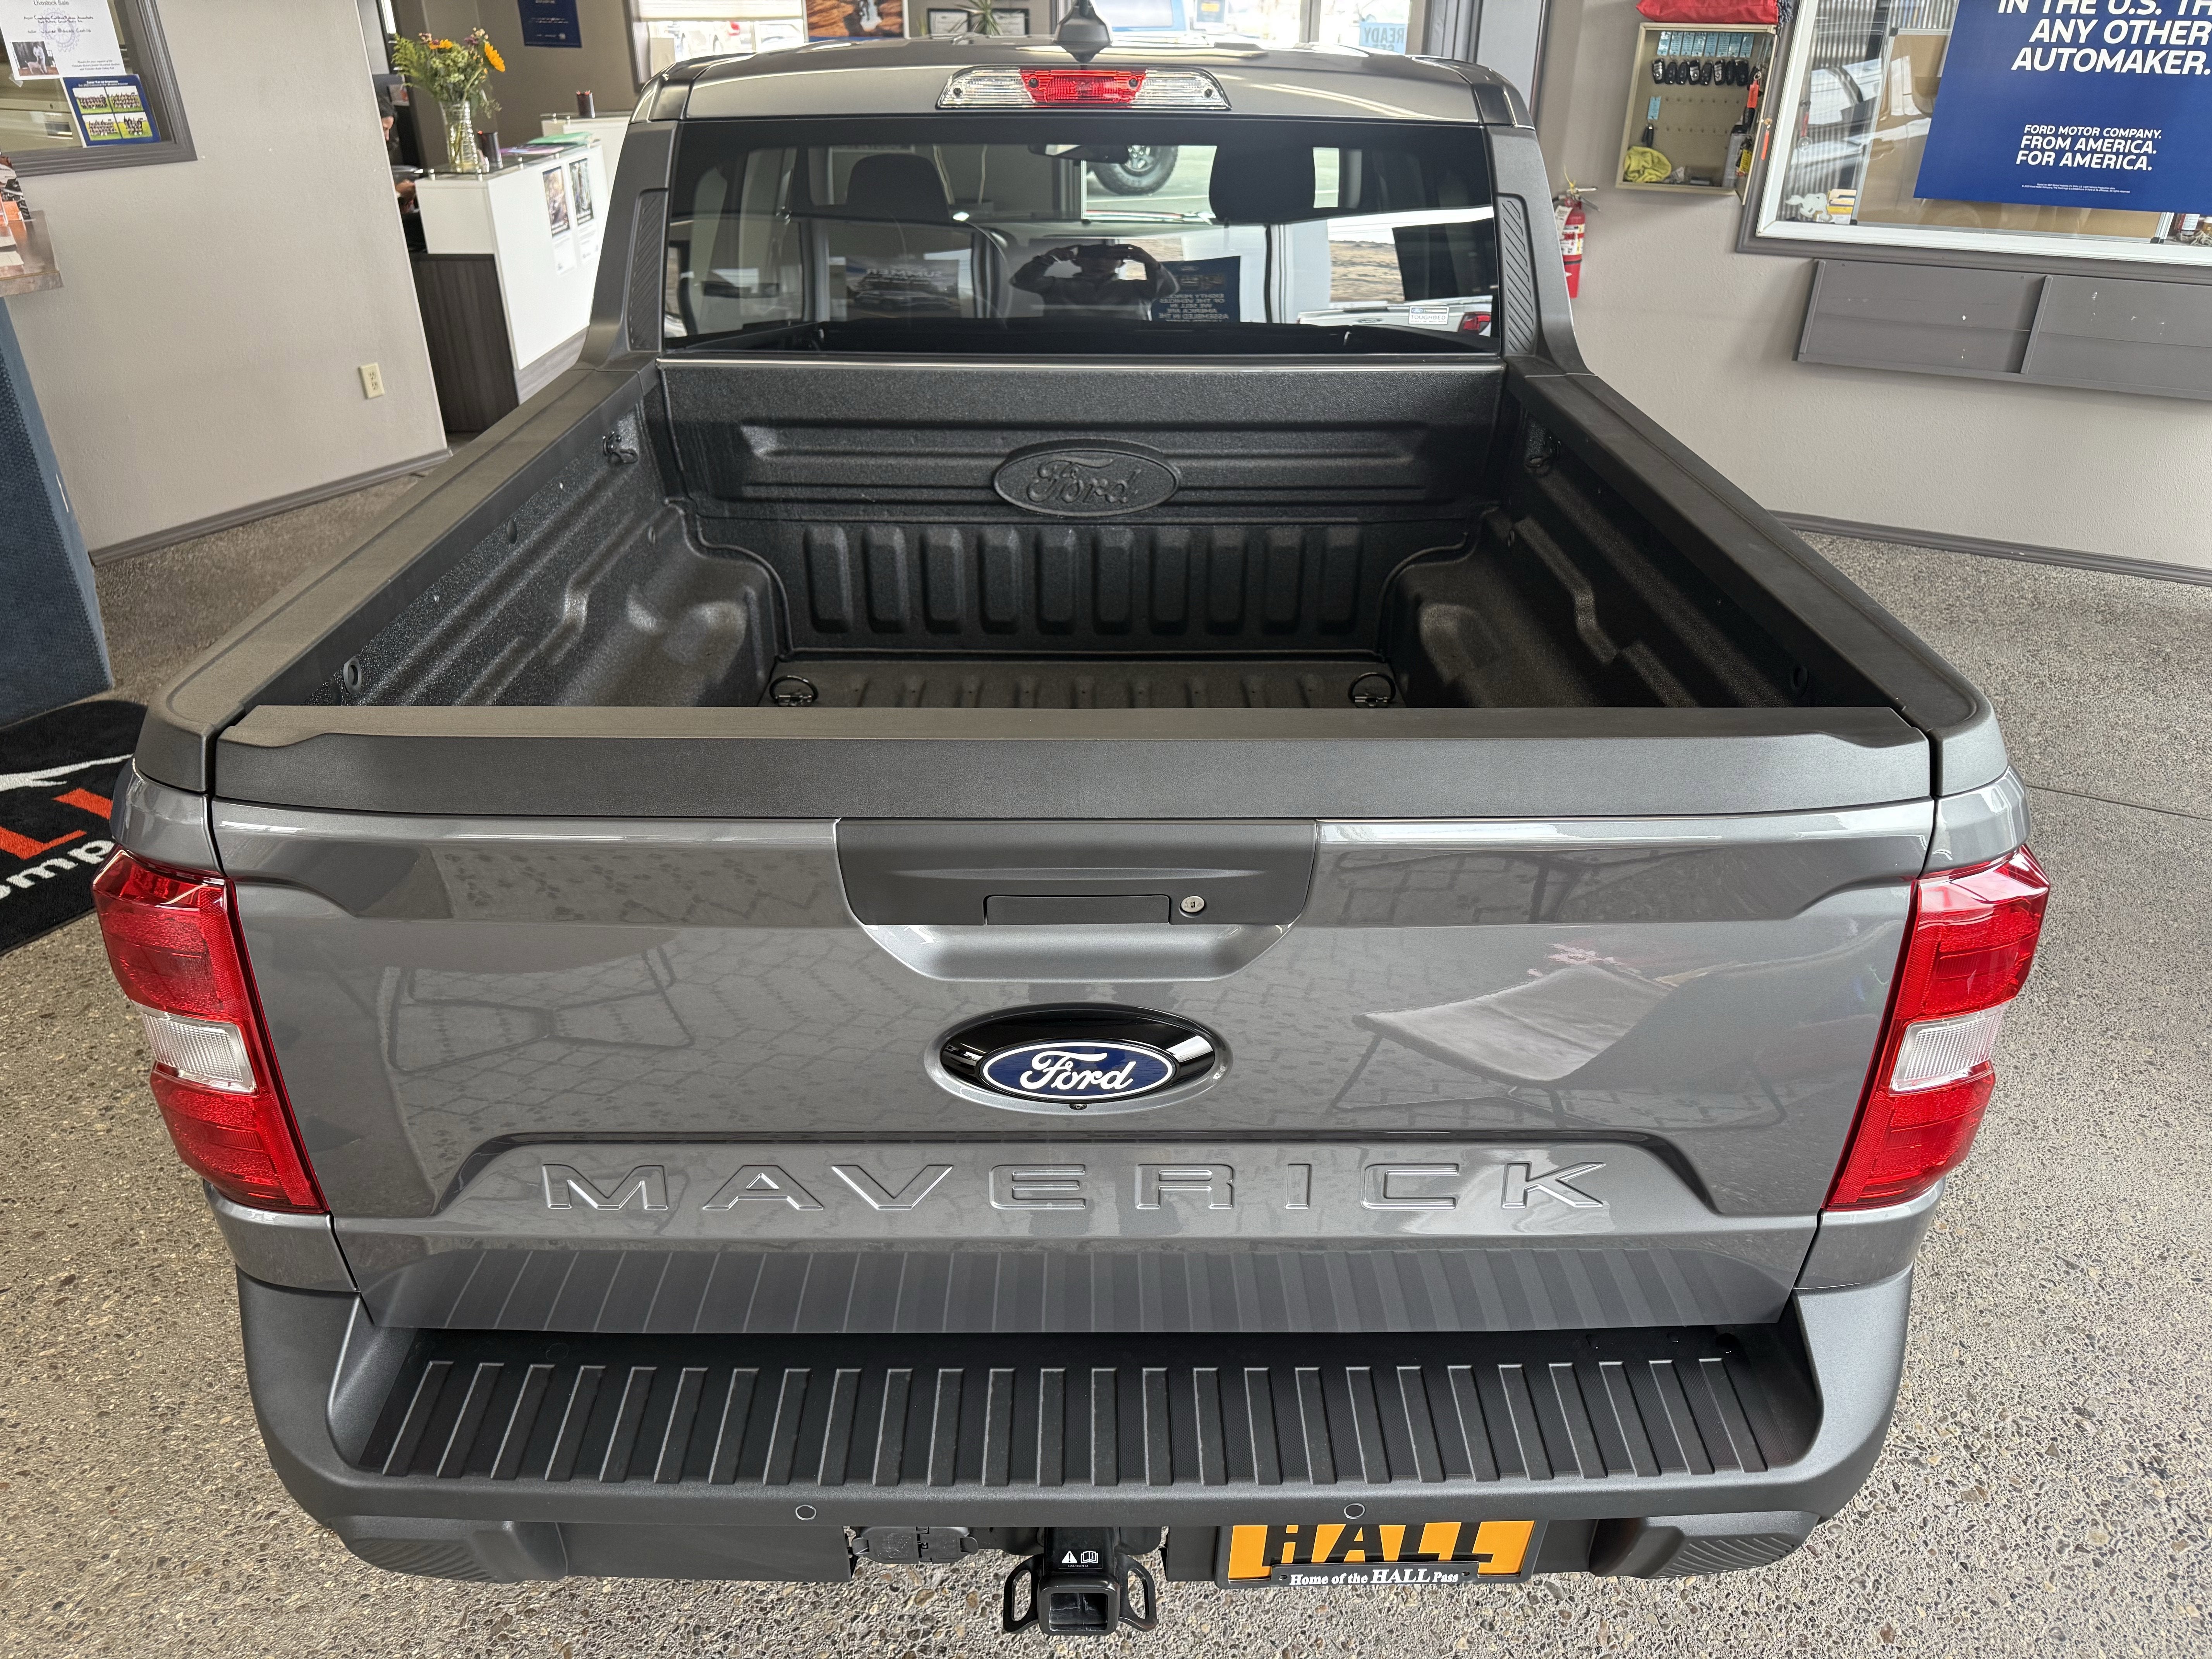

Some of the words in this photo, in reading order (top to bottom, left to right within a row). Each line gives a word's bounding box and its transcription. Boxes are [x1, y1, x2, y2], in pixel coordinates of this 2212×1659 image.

[1998, 0, 2028, 13] IN
[2043, 0, 2096, 14] THE
[2108, 0, 2162, 15] U.S.
[2029, 19, 2098, 43] ANY
[2104, 20, 2212, 45] OTHER
[2011, 47, 2210, 75] AUTOMAKER.
[2024, 125, 2055, 134] FORD
[2058, 126, 2100, 136] MOTOR
[2103, 128, 2161, 139] COMPANY.
[2021, 136, 2071, 150] FROM
[2074, 138, 2156, 154] AMERICA.
[2016, 151, 2055, 165] FOR
[2059, 153, 2152, 170] AMERICA.
[1026, 457, 1142, 503] Ford
[1020, 1051, 1136, 1090] Ford
[541, 1162, 1606, 1211] MAVERICK
[1289, 1574, 1328, 1585] Home
[1331, 1573, 1347, 1584] of
[1347, 1573, 1368, 1583] the
[1370, 1568, 1431, 1583] HALL
[1432, 1571, 1459, 1583] Pass
